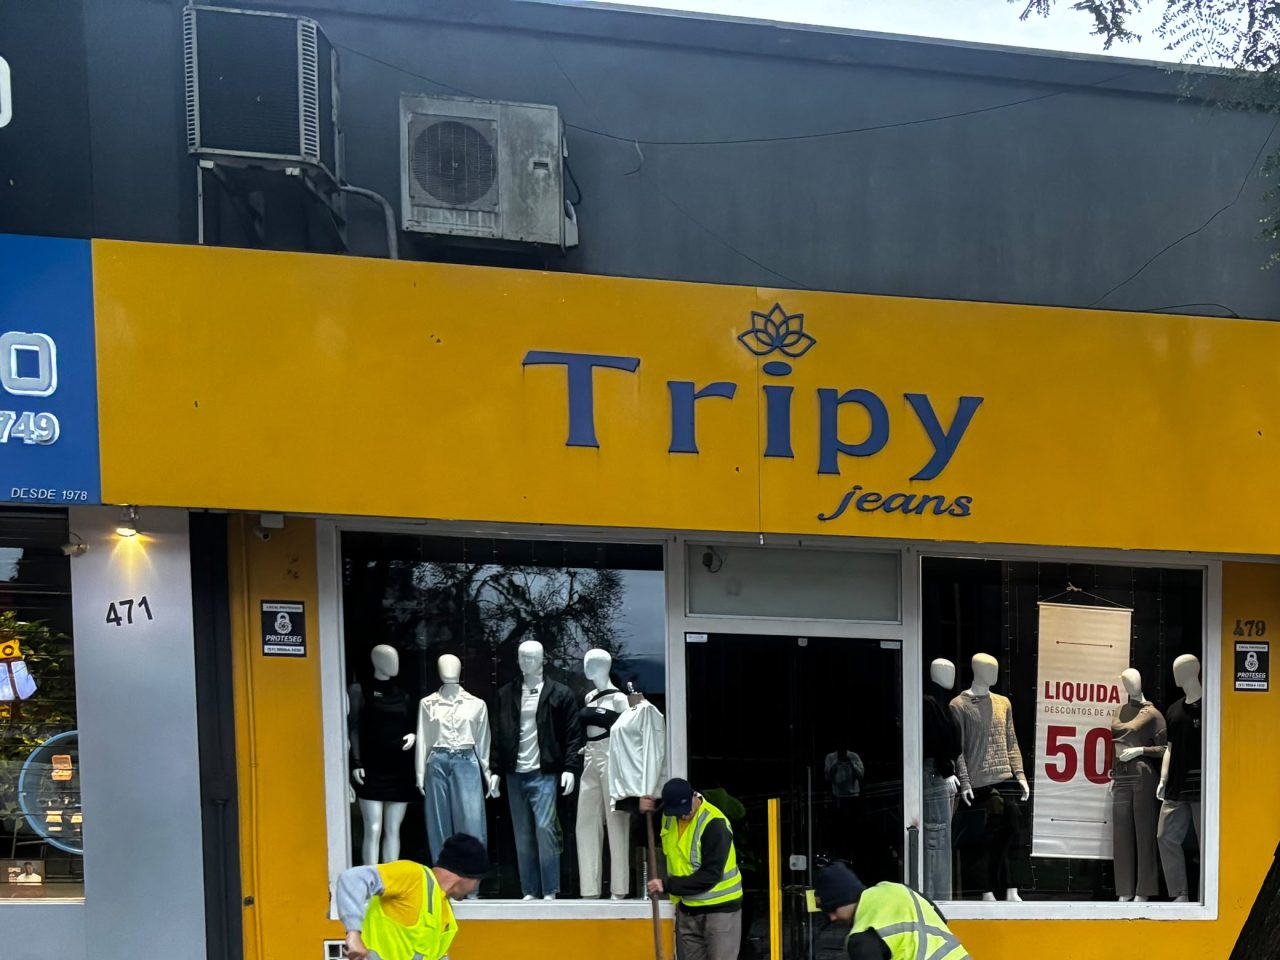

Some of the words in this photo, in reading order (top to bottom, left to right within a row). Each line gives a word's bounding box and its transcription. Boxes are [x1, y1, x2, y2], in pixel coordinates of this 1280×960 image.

[522, 350, 985, 482] Tripy
[11, 487, 57, 500] DESDE
[62, 490, 88, 501] 1978
[817, 484, 973, 521] jeans
[106, 596, 153, 626] 471
[265, 634, 303, 643] PROTESEG
[1233, 620, 1266, 637] 479
[1044, 681, 1121, 704] LIQUIDA
[1044, 706, 1092, 716] DESCONTOS
[1094, 708, 1104, 717] DE
[1106, 709, 1116, 718] AT
